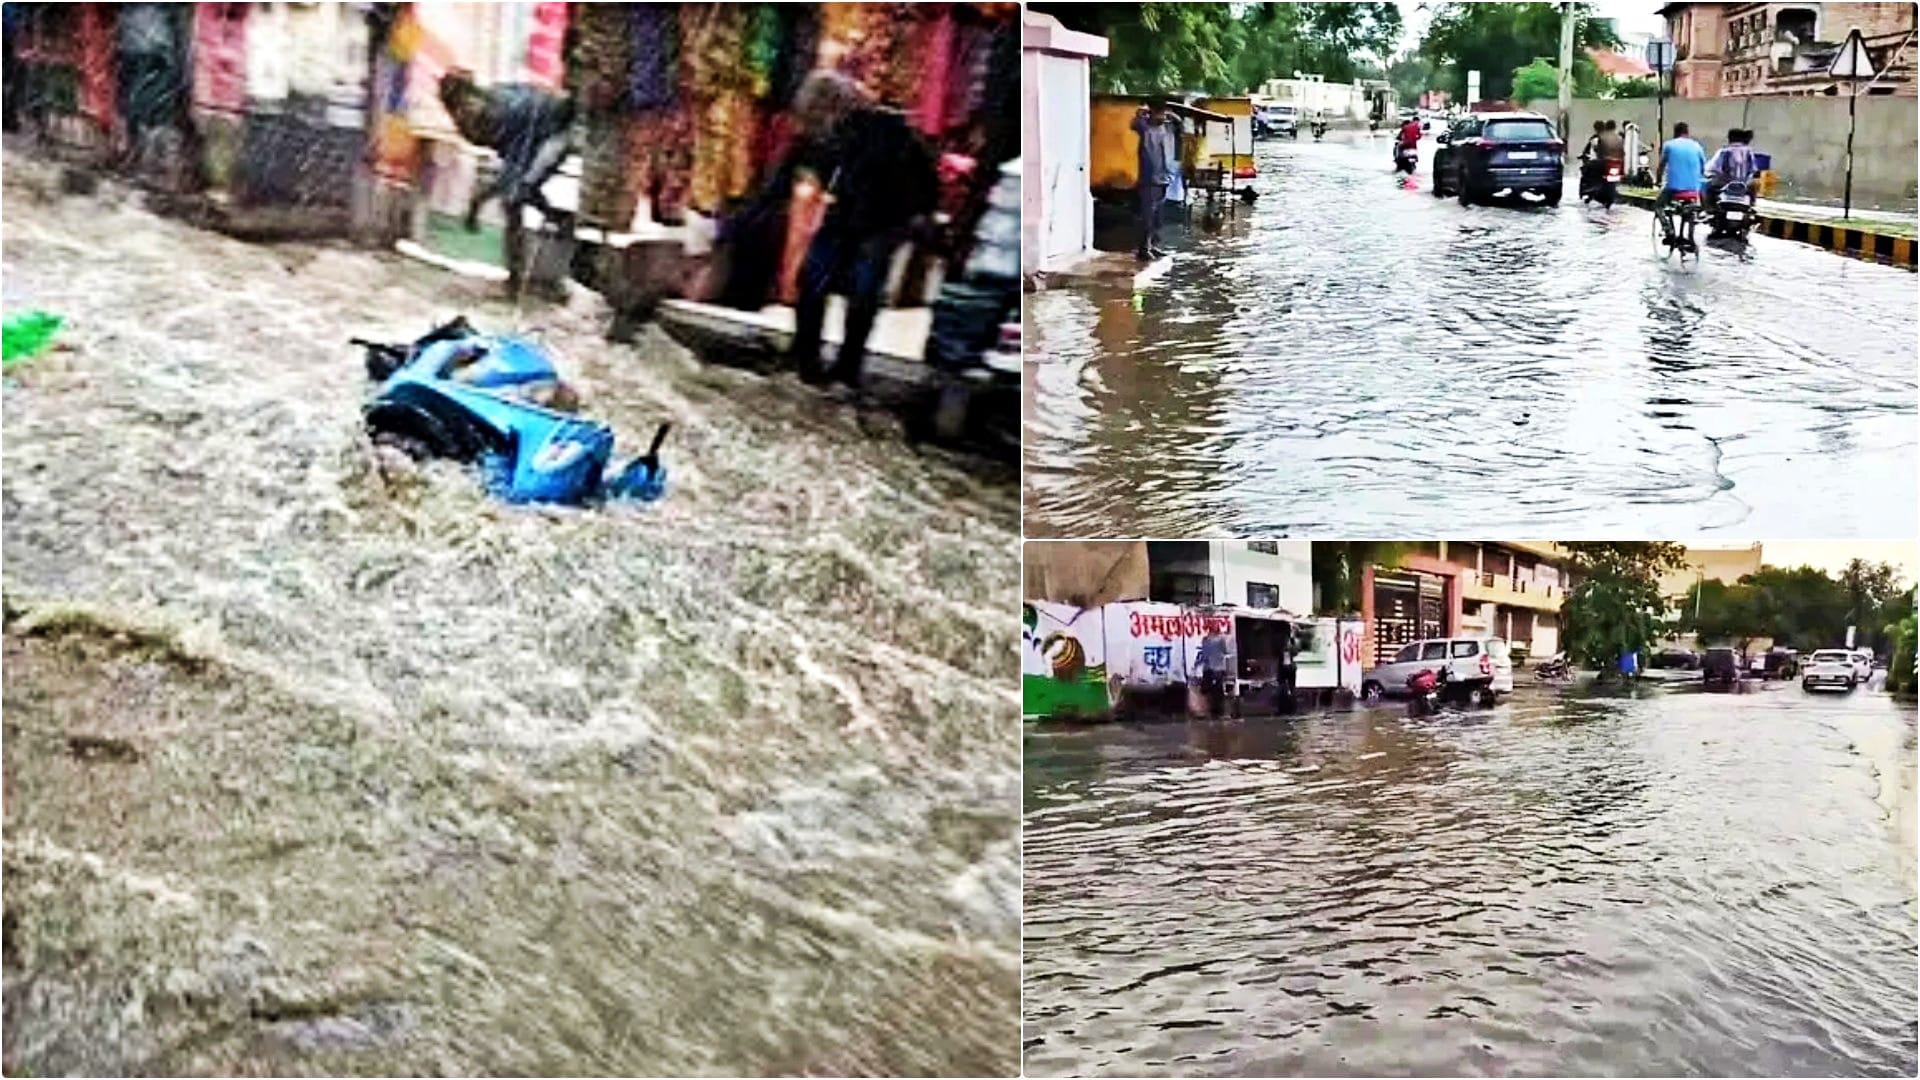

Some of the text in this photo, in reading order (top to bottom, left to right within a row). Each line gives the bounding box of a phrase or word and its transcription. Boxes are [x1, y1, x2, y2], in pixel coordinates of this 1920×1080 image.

[1129, 611, 1181, 641] अमूल
[1184, 611, 1231, 638] अमल
[1143, 646, 1173, 675] दूध
